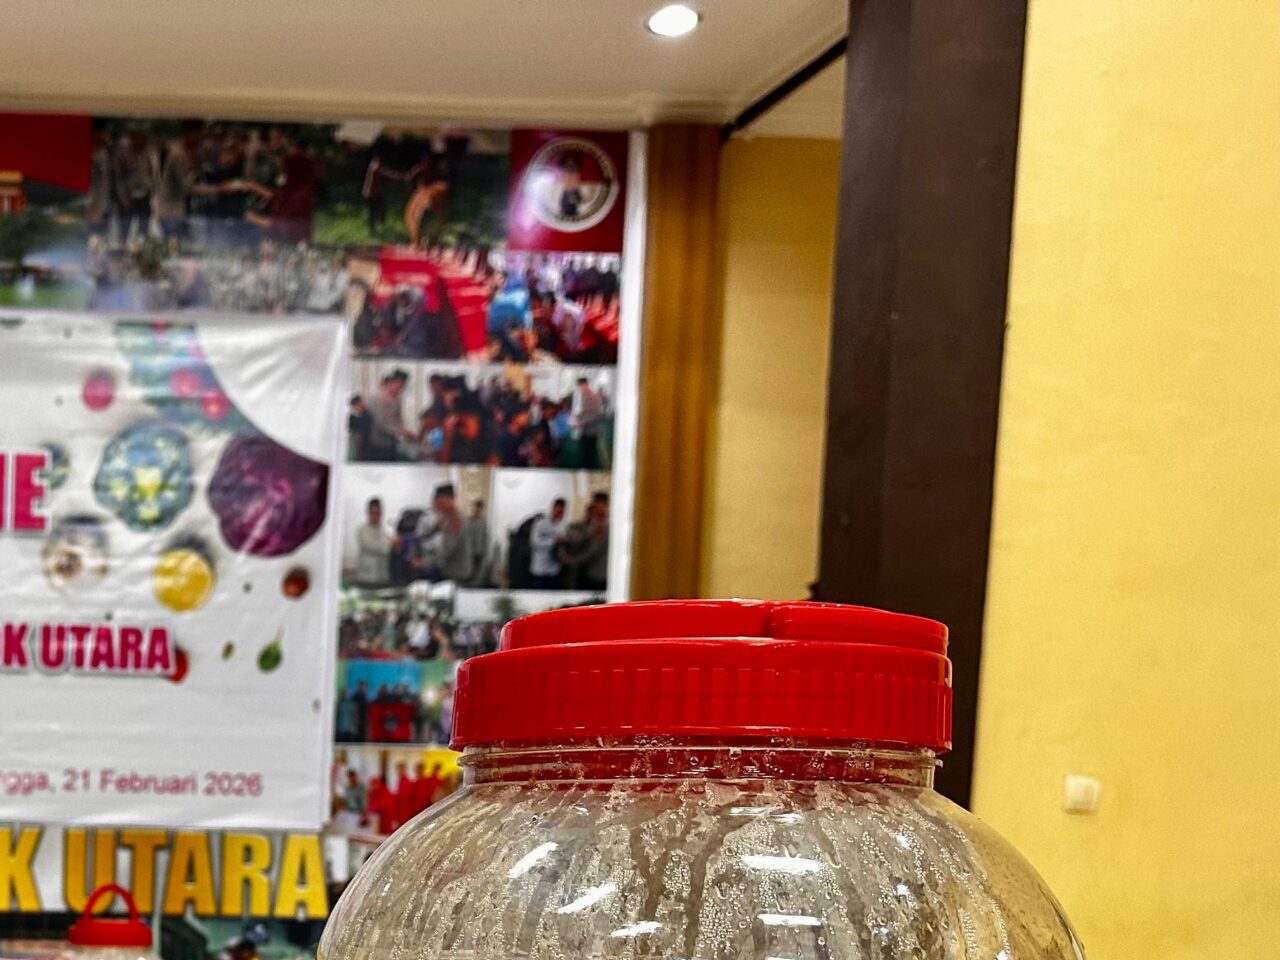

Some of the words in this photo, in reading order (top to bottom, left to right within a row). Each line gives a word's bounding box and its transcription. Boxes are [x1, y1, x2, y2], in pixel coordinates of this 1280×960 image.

[40, 624, 173, 671] UTARA
[63, 768, 92, 792] 21
[99, 769, 198, 795] Februari
[204, 772, 264, 796] 2026
[64, 825, 329, 920] UTARA
